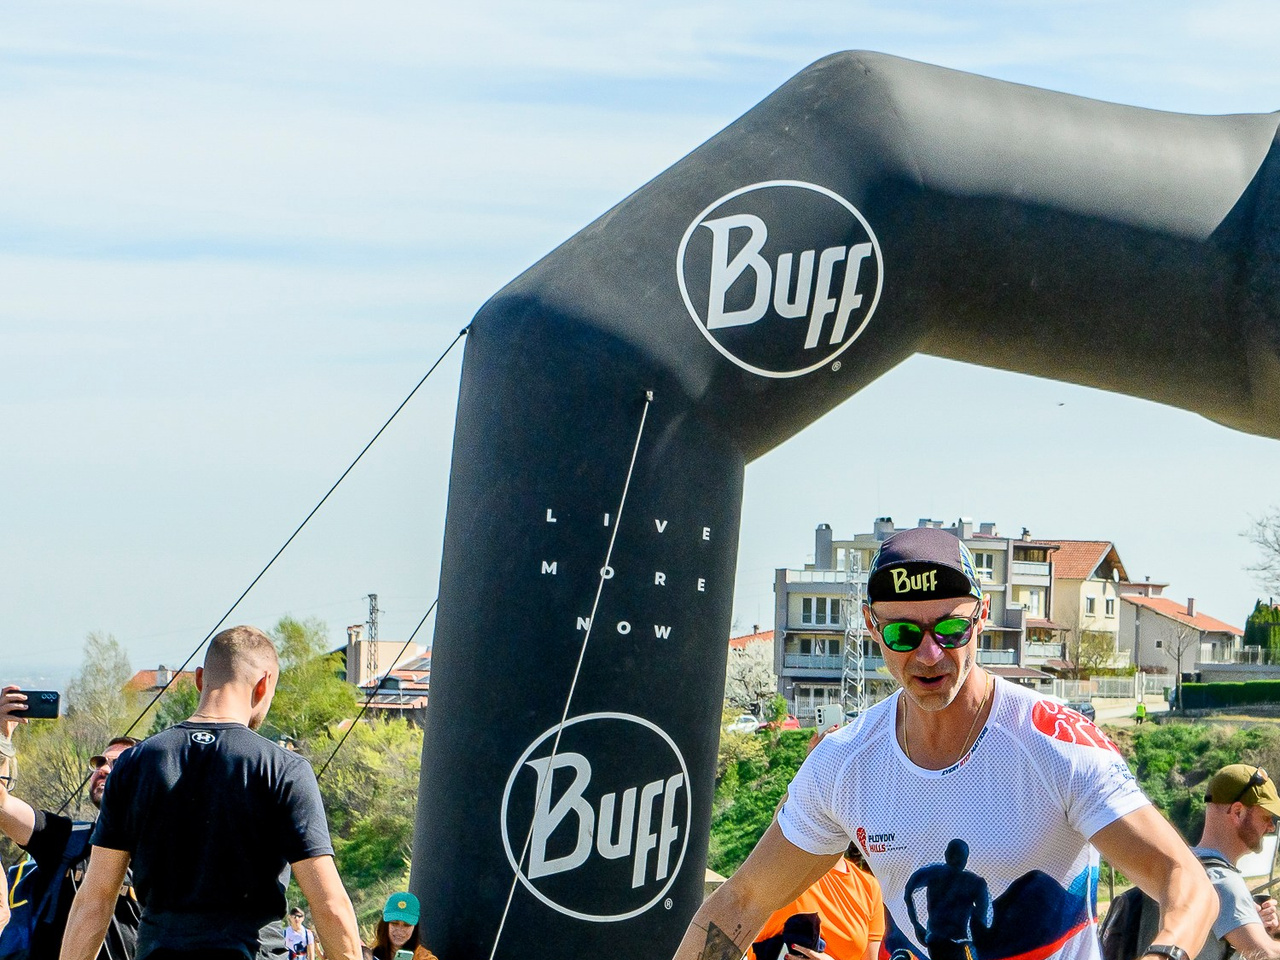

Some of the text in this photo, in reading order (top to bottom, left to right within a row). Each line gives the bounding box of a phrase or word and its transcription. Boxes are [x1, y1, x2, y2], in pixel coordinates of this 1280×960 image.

[546, 509, 711, 541] LIVE
[541, 561, 705, 592] MORE
[576, 617, 671, 640] NOW
